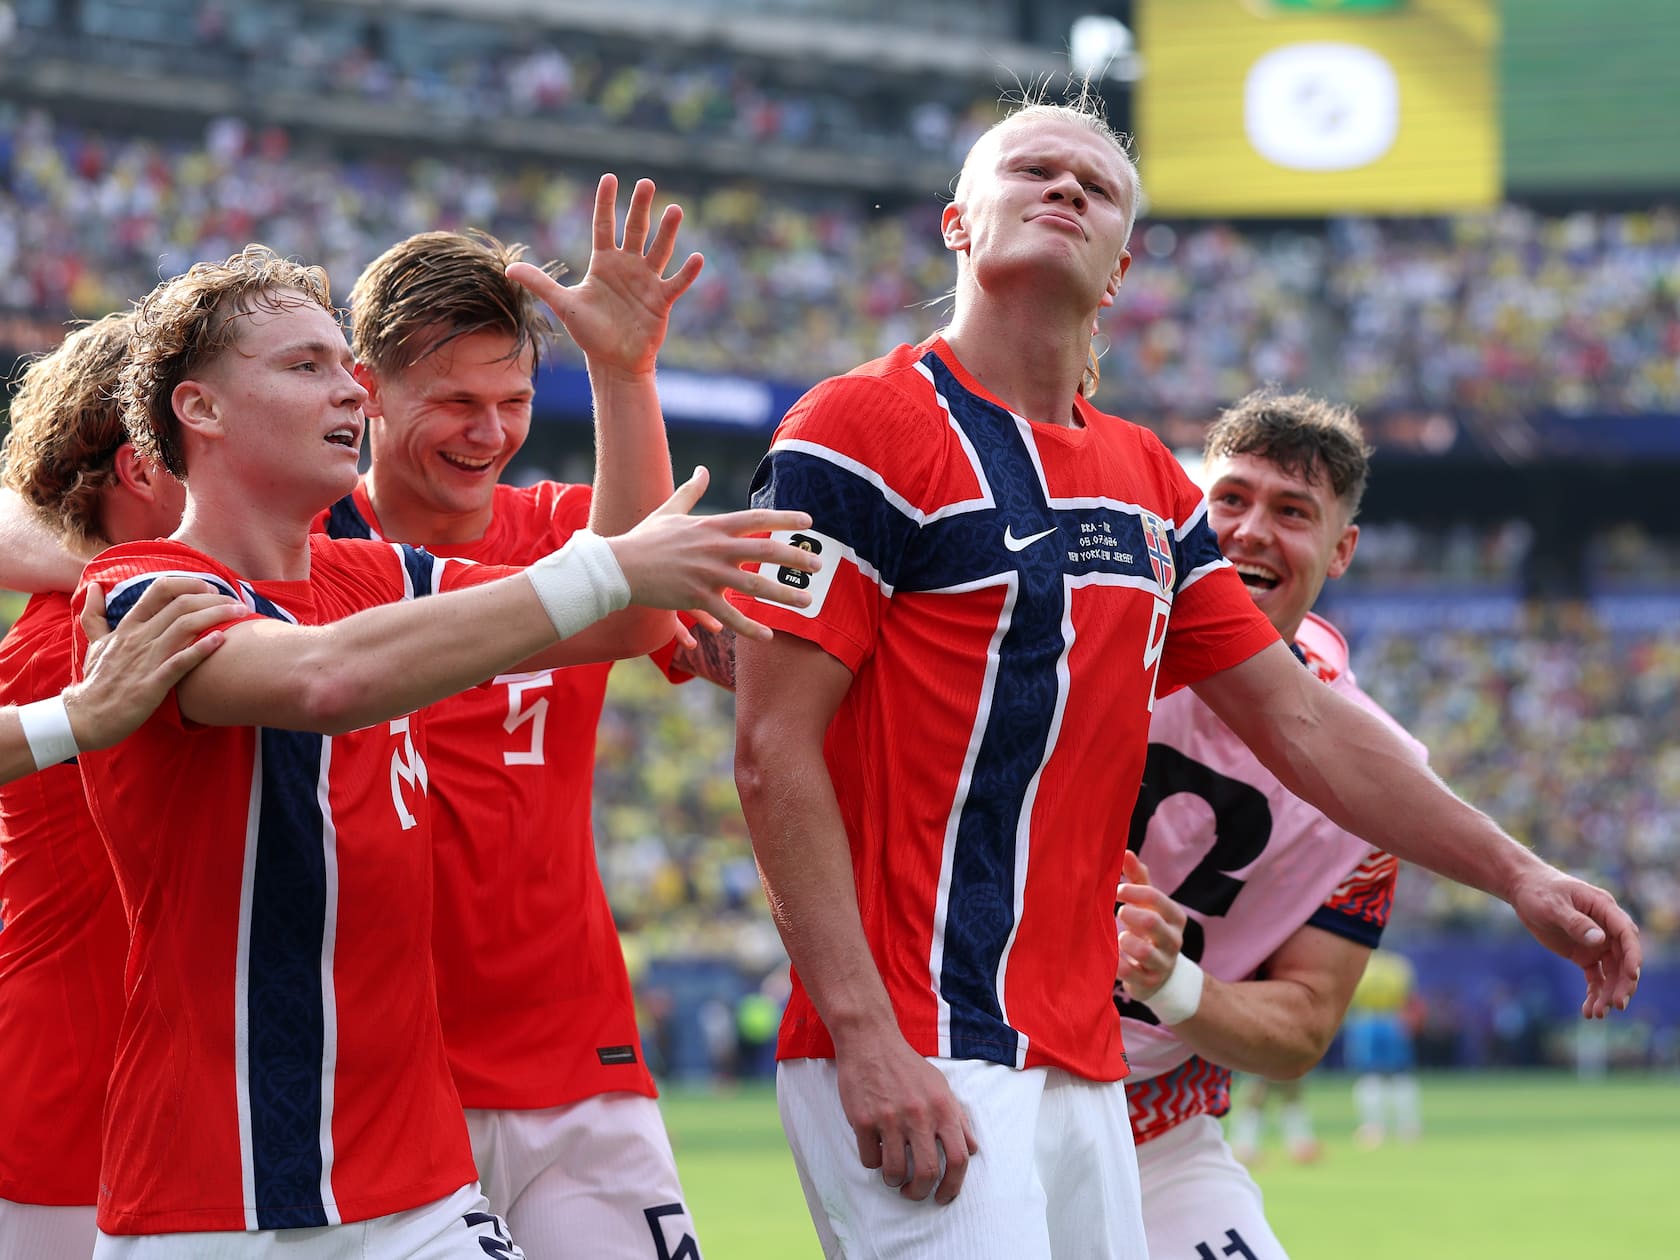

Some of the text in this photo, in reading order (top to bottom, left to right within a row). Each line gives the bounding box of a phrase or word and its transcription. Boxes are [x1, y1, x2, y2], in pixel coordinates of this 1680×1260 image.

[1080, 549, 1101, 562] YORK
[785, 574, 801, 585] FIFA
[502, 674, 554, 766] 5
